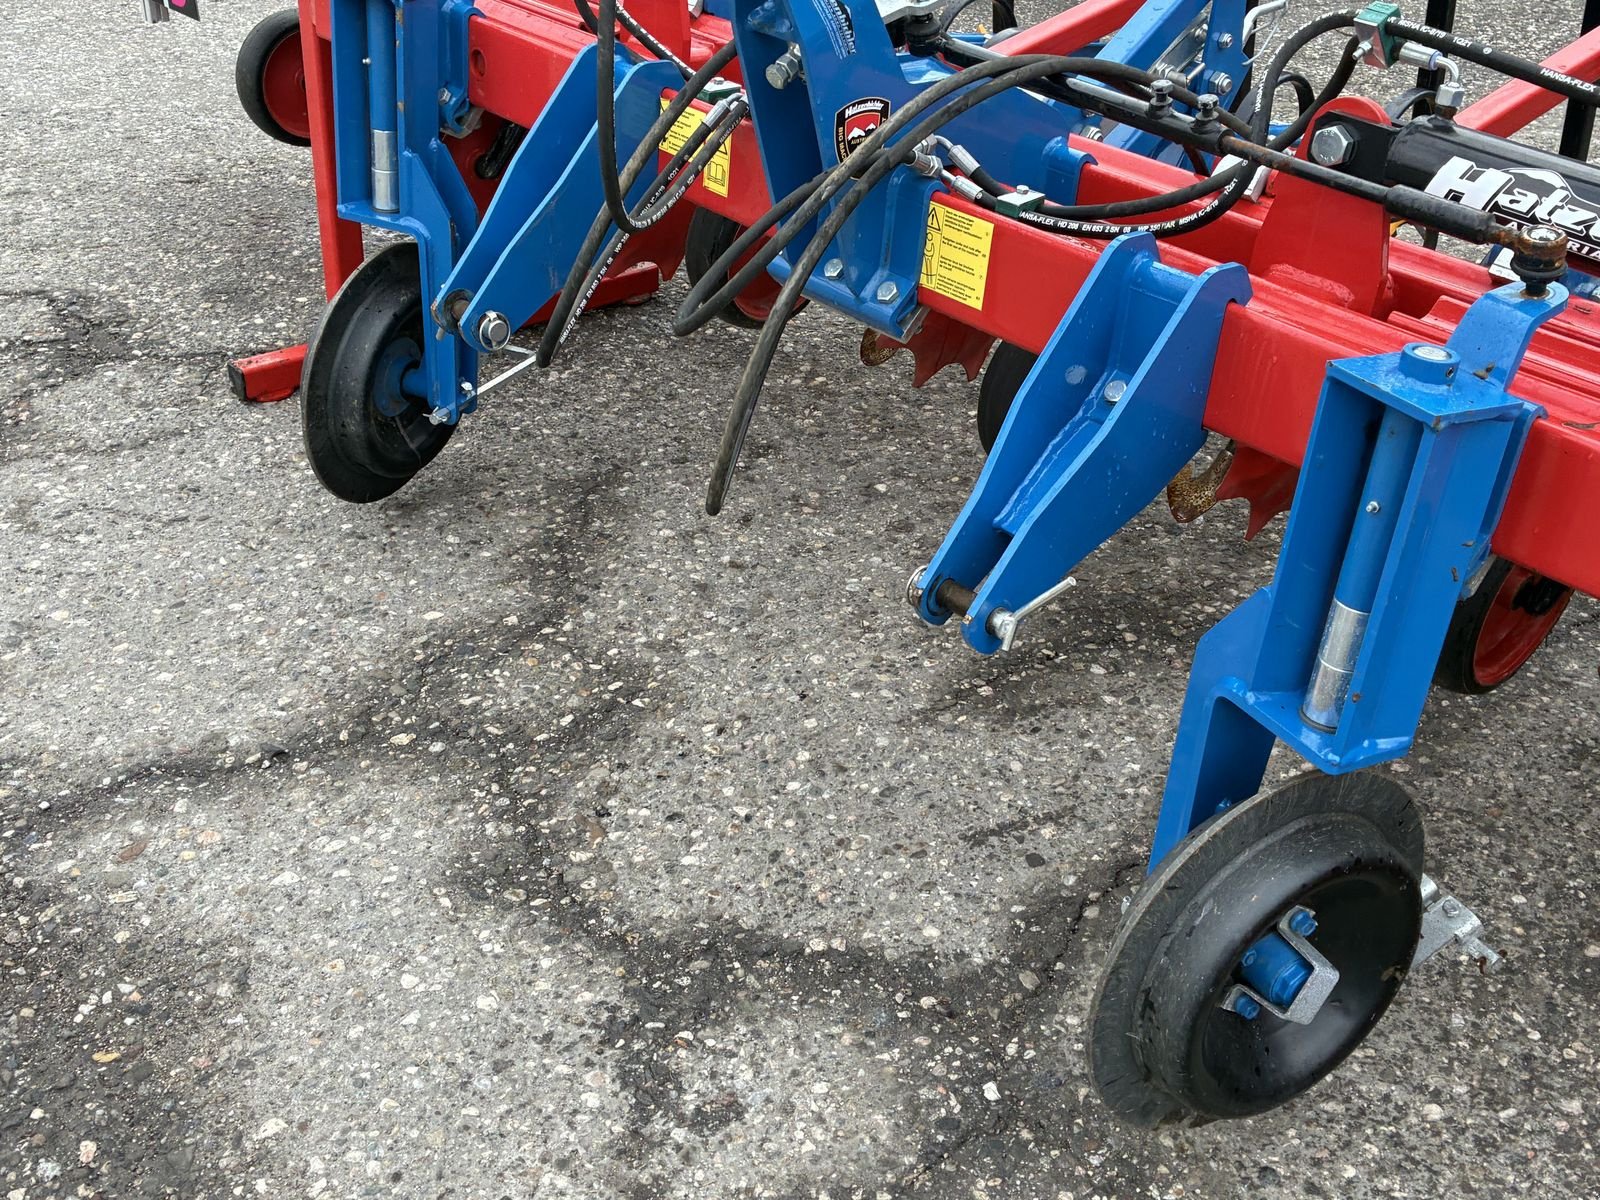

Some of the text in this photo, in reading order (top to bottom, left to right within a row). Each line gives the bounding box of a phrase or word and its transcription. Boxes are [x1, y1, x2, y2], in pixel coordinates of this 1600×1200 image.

[1540, 67, 1597, 93] HANSA-FLEX
[1057, 220, 1068, 229] HD
[1081, 224, 1093, 233] EN
[1109, 226, 1121, 235] SN
[1178, 212, 1198, 226] MSHA
